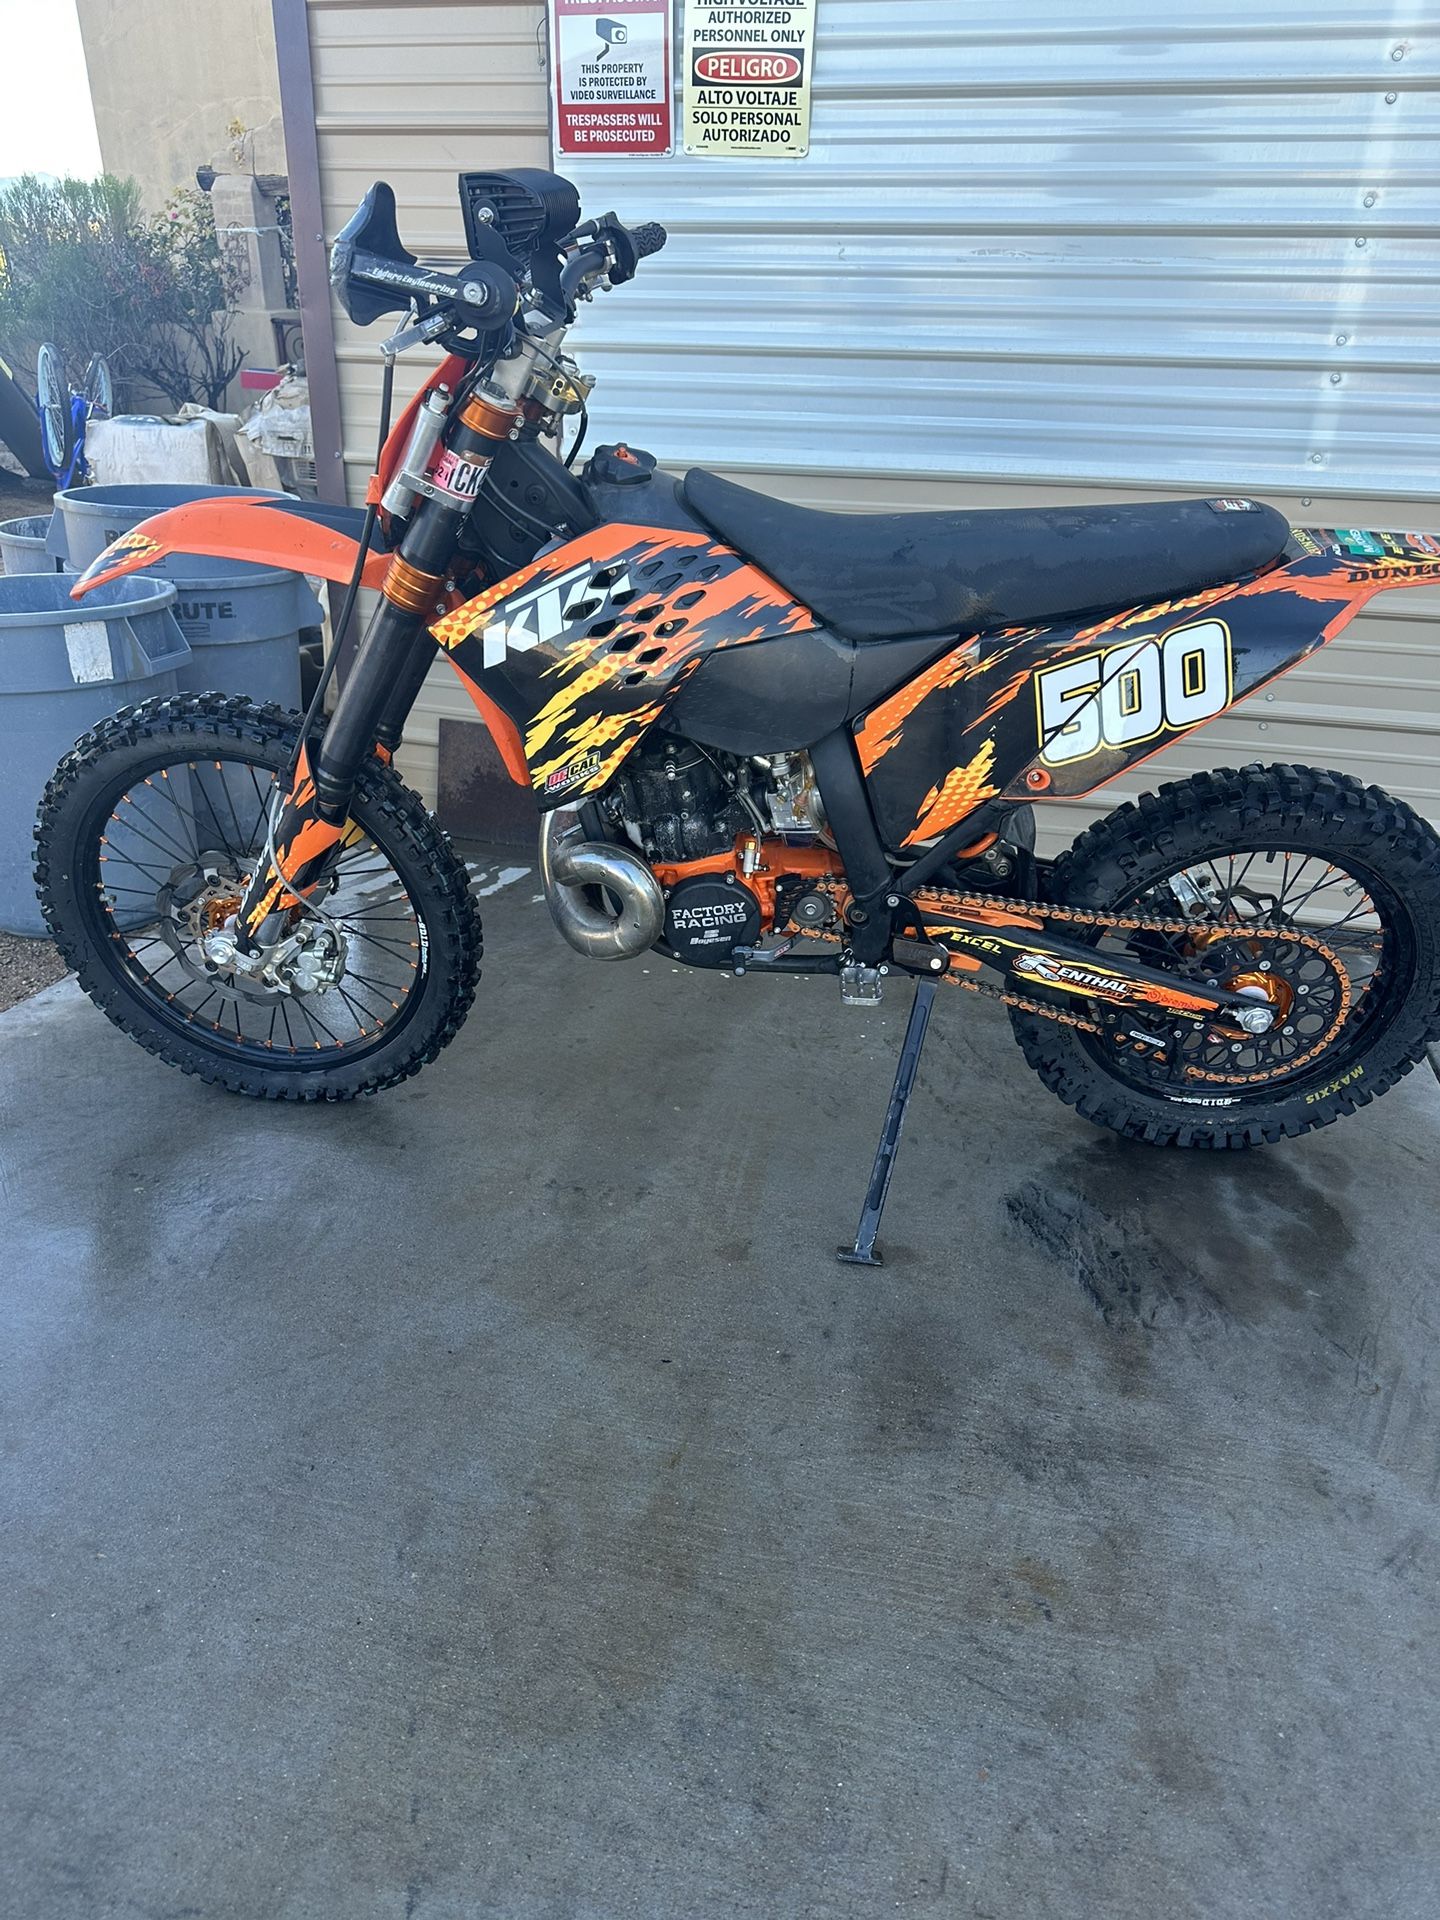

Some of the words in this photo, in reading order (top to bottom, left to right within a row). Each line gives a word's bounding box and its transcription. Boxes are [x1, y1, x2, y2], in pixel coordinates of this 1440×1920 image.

[708, 11, 791, 24] AUTHORIZED
[693, 29, 768, 42] PERSONNEL
[771, 30, 805, 42] ONLY
[581, 64, 600, 74] THIS
[602, 63, 644, 73] PROPERTY
[708, 58, 787, 77] PELIGRO
[578, 78, 587, 87] IS
[589, 77, 634, 87] PROTECTED
[636, 76, 647, 86] BY
[570, 91, 595, 100] VIDEO
[596, 89, 656, 99] SURVEILLANCE
[697, 90, 733, 104] ALTO
[736, 91, 797, 105] VOLTAJE
[566, 114, 636, 126] TRESPASSERS
[637, 114, 662, 126] WILL
[692, 111, 728, 124] SOLO
[731, 112, 802, 126] PERSONAL
[574, 131, 588, 142] BE
[590, 130, 655, 142] PROSECUTED
[703, 128, 791, 143] AUTORIZADO
[172, 602, 235, 620] RUTE
[483, 558, 632, 669] KTM
[1034, 618, 1233, 768] 500
[672, 902, 745, 920] FACTORY
[674, 913, 747, 929] RACING
[689, 935, 732, 945] Boyesen
[950, 932, 1002, 955] EXCEL
[1306, 1065, 1364, 1104] MAXXIS
